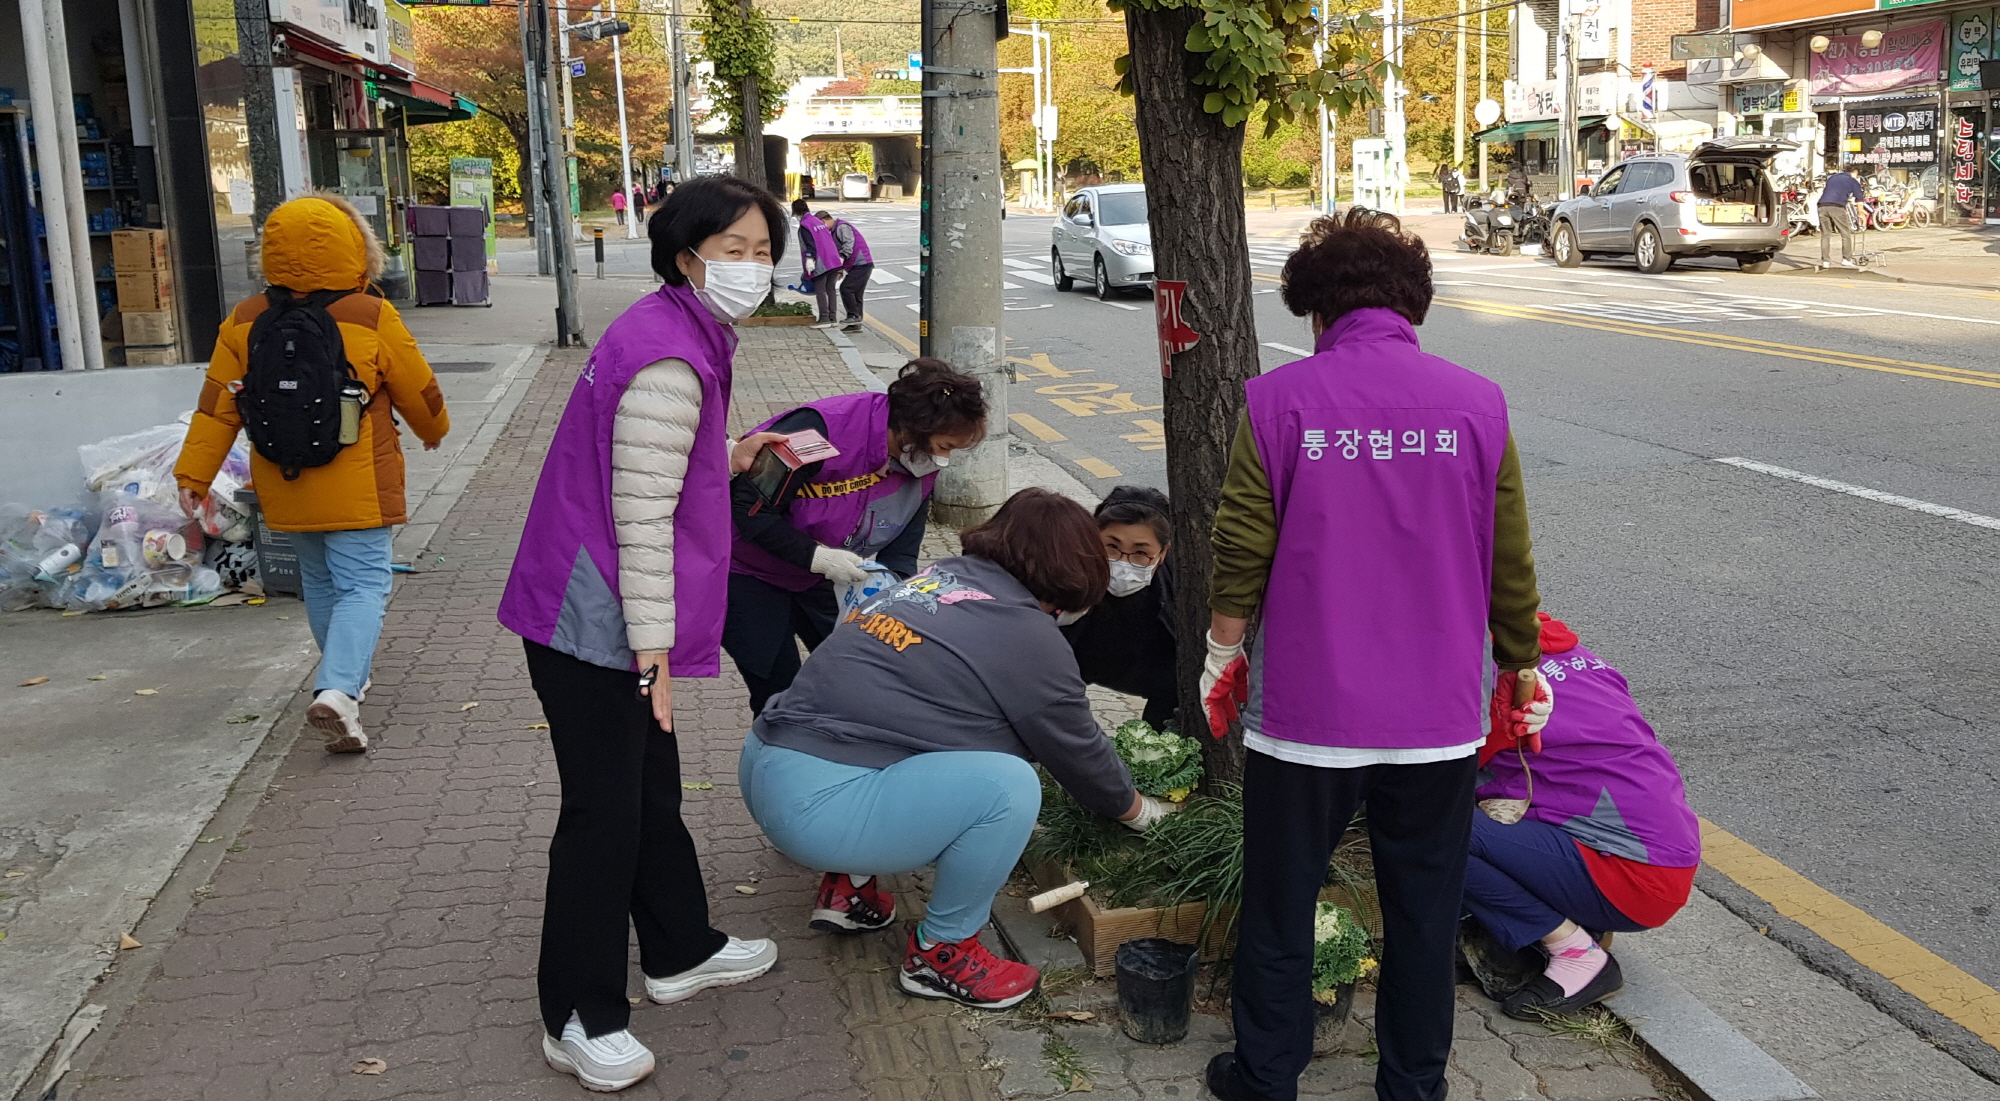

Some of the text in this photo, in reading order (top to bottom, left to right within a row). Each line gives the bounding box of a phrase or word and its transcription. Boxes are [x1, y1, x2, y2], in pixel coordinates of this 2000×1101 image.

[1584, 19, 1599, 42] 치킨
[1964, 26, 1981, 39] 광택
[1848, 110, 1934, 133] 오토바이 MTB 자전거
[1301, 429, 1458, 460] 통장협의회
[821, 476, 872, 495] DO NOT CROSS
[859, 612, 922, 653] JERRY
